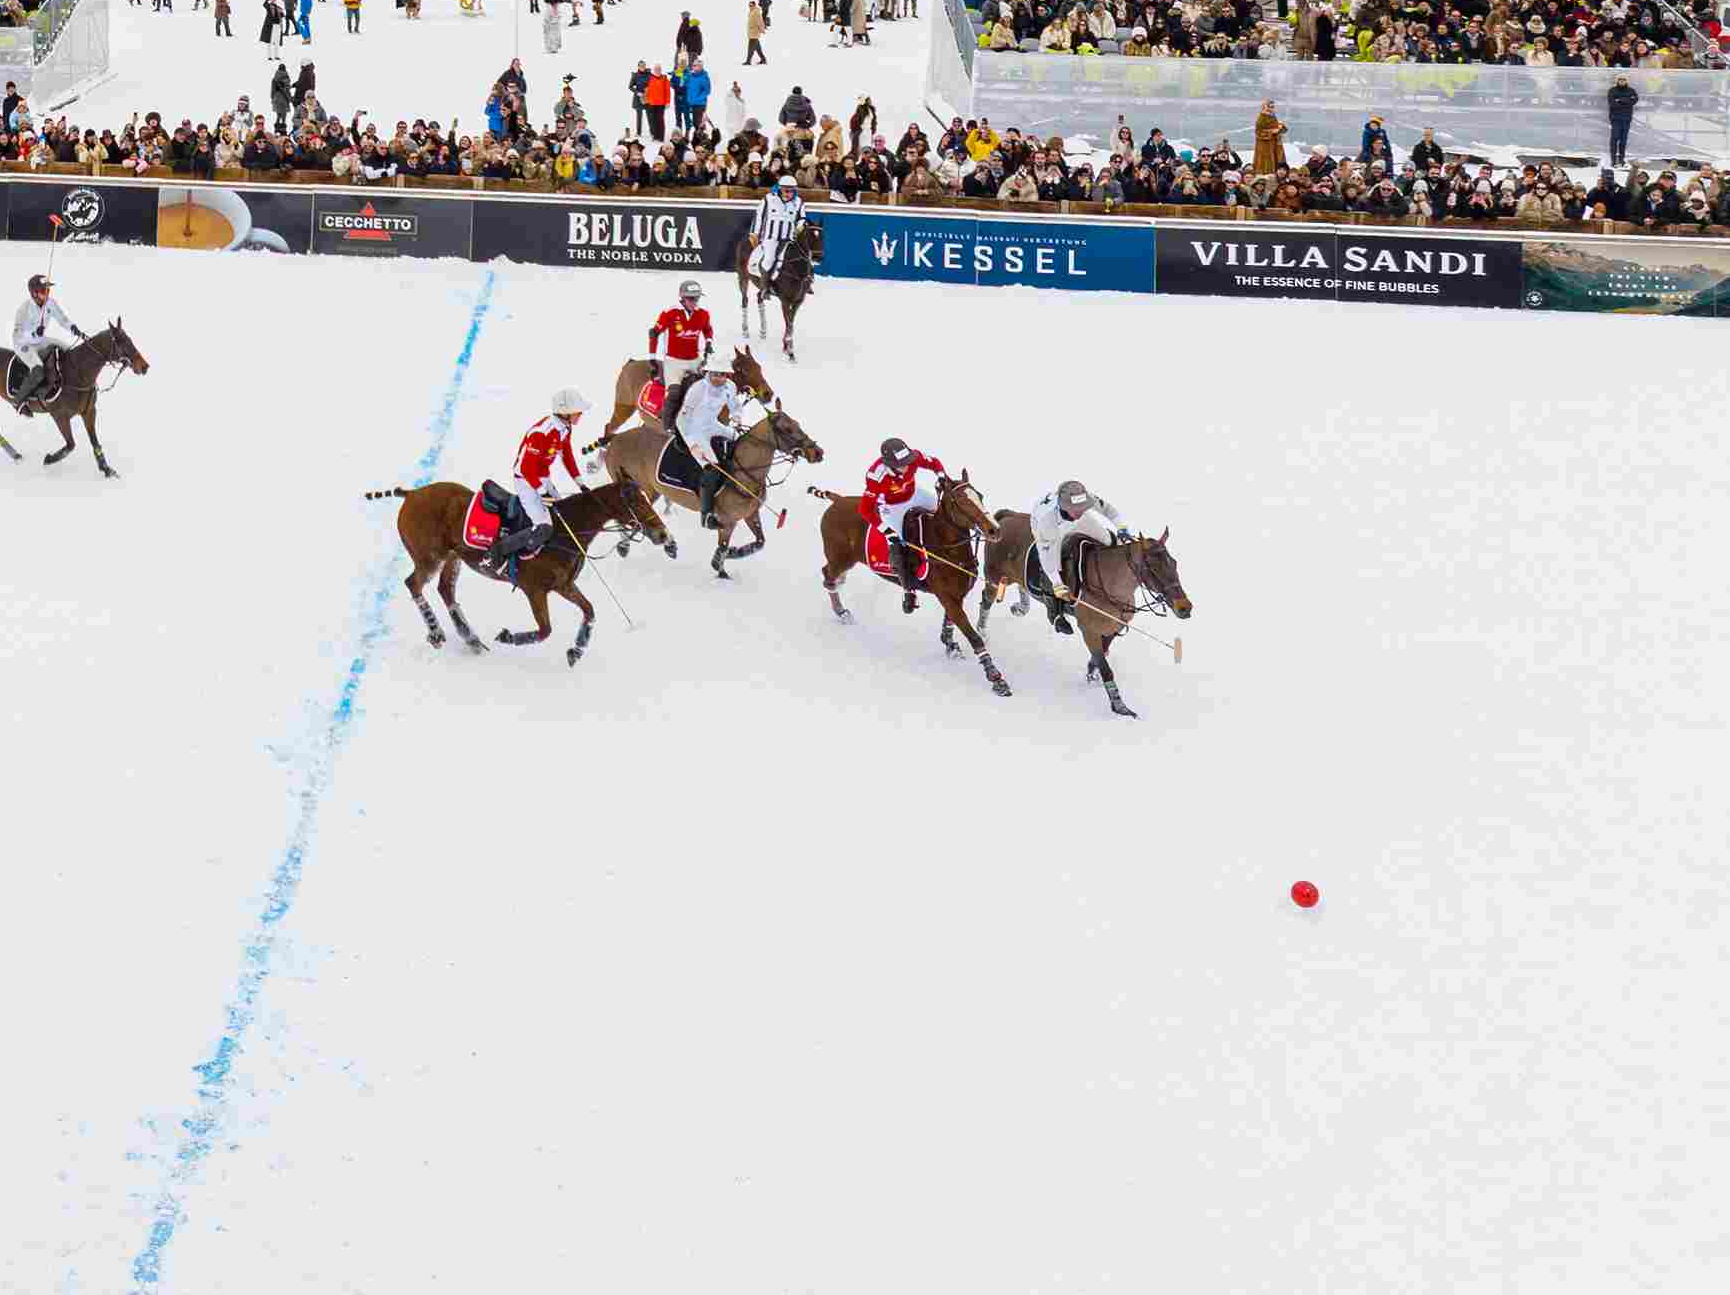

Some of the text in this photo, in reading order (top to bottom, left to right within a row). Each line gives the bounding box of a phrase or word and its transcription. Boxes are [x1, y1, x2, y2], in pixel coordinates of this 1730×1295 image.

[324, 216, 411, 230] CECCHETTO
[567, 212, 703, 249] BELUGA
[567, 249, 702, 264] THE NOBLE VODKA
[913, 241, 1087, 275] KESSEL
[1190, 241, 1487, 276] VILLA SANDI
[1235, 275, 1439, 294] THE ESSENCE OF FINE BUBBLES
